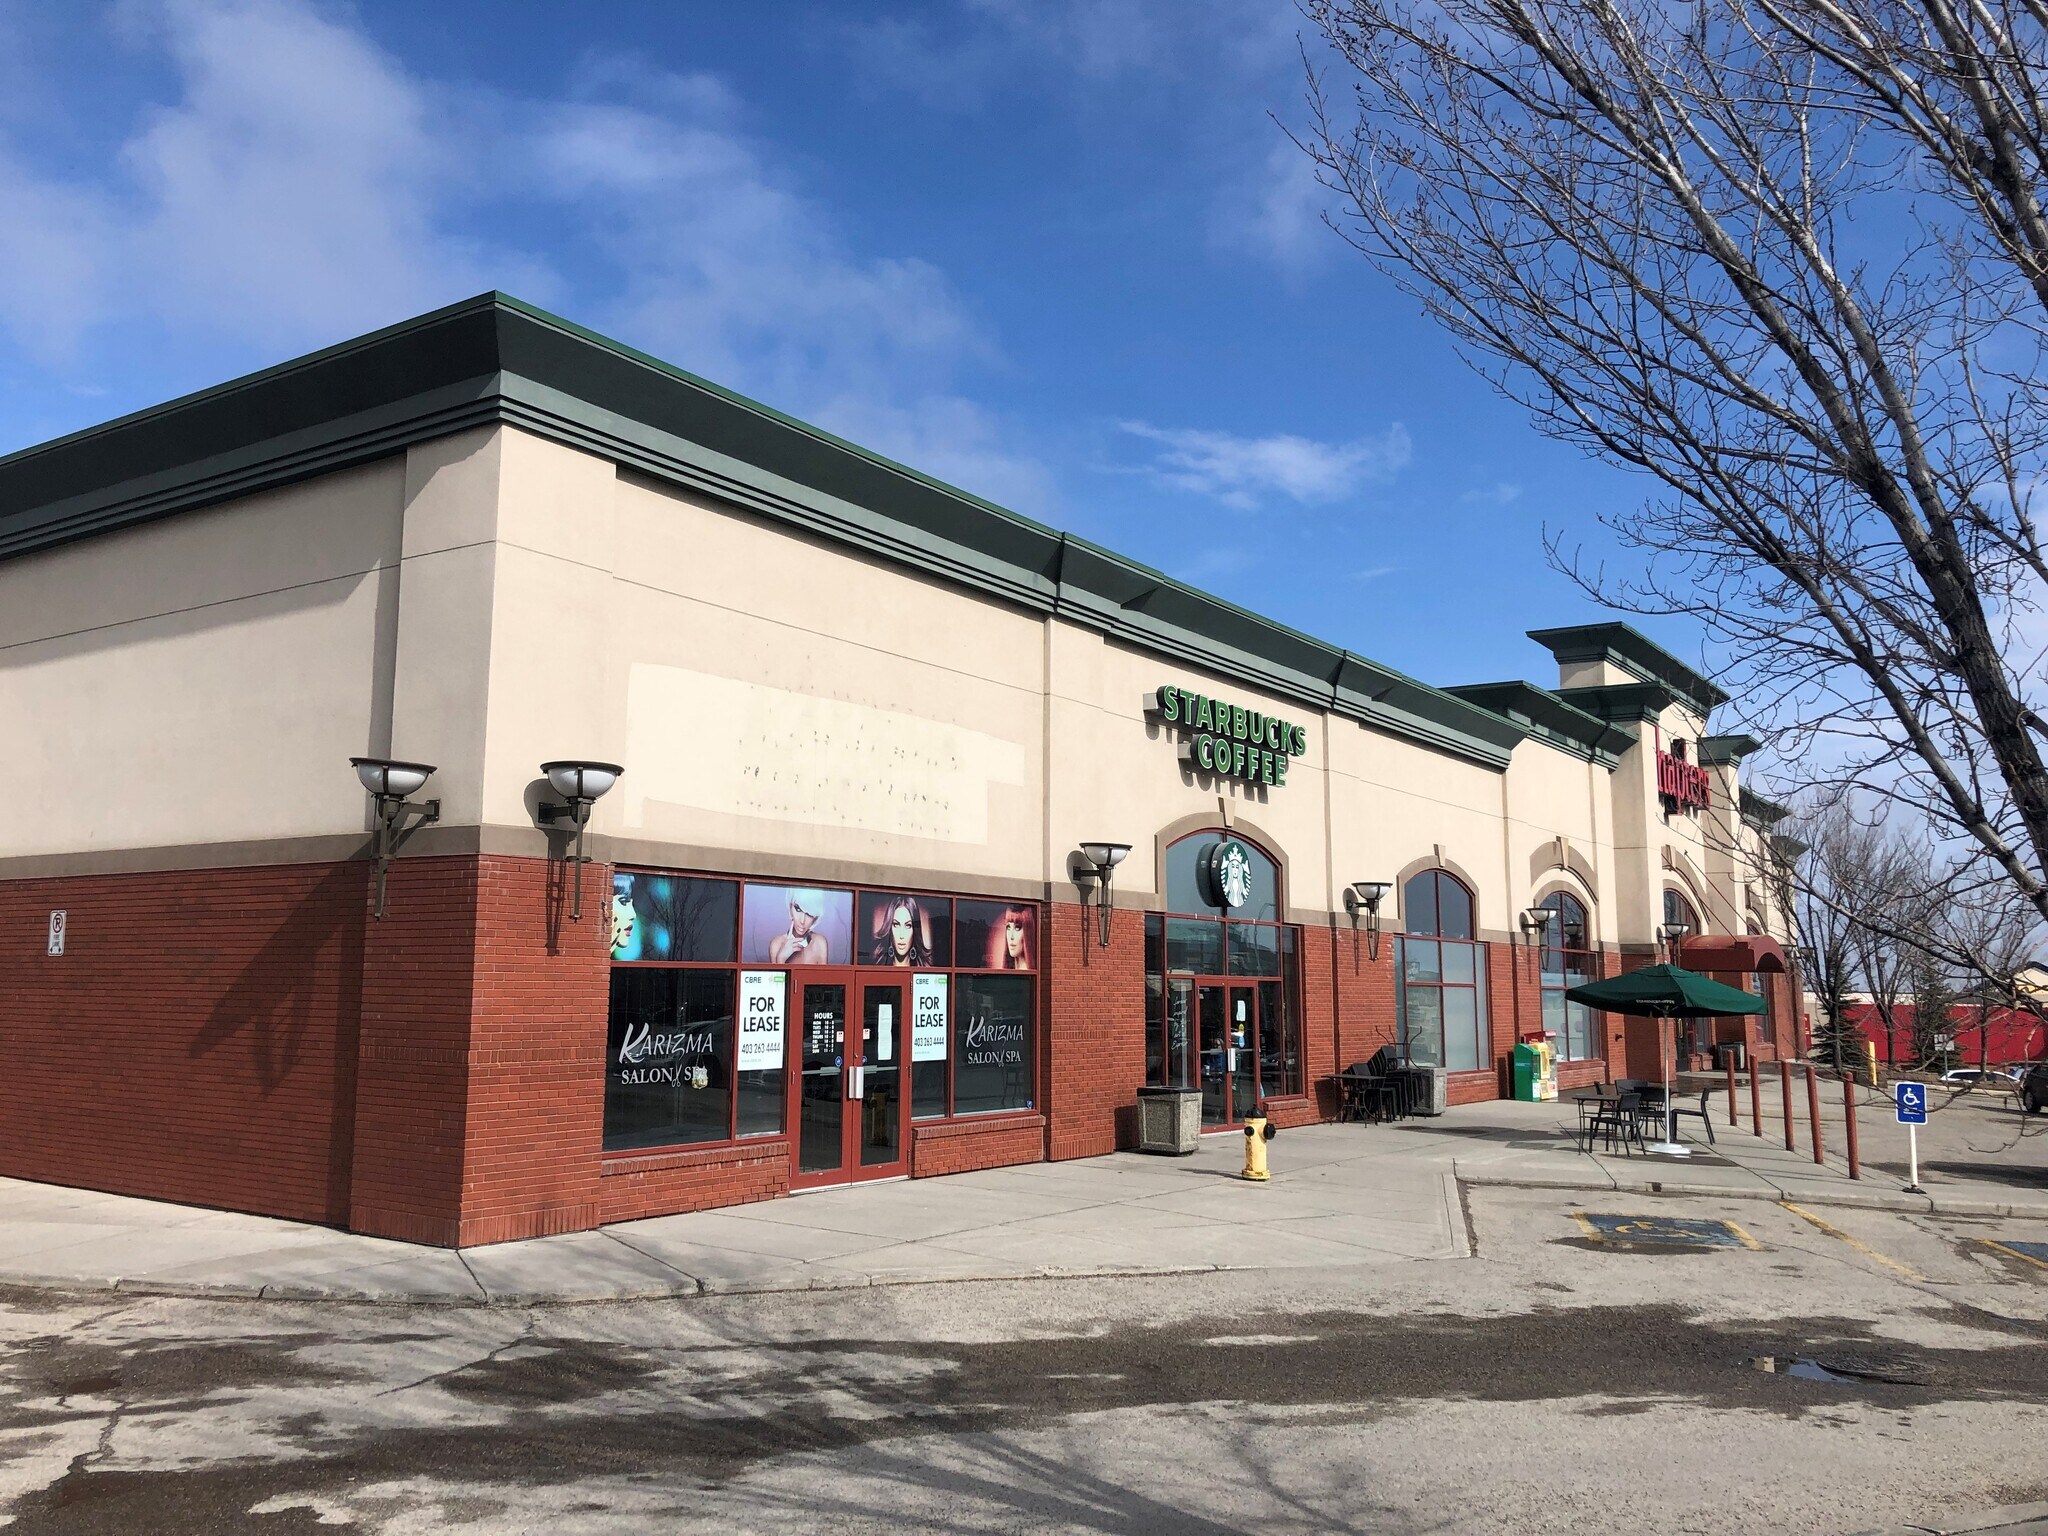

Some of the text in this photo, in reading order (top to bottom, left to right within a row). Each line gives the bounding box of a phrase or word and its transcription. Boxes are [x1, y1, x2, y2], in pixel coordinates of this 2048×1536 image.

[1160, 685, 1306, 757] STARBUCKS
[1194, 733, 1287, 787] COFFEE
[744, 976, 762, 984] CBRE
[749, 996, 775, 1013] FOR
[919, 996, 940, 1010] FOR
[814, 1012, 834, 1020] HOURS
[915, 1013, 944, 1028] LEASE
[743, 1016, 780, 1032] LEASE
[966, 1015, 1024, 1048] KARIZMA
[618, 1022, 713, 1064] KARIZMA
[741, 1042, 780, 1054] 403 263 4444
[914, 1036, 945, 1047] 403 263 4444
[967, 1050, 1022, 1065] SALON SPA
[621, 1067, 674, 1085] SALON
